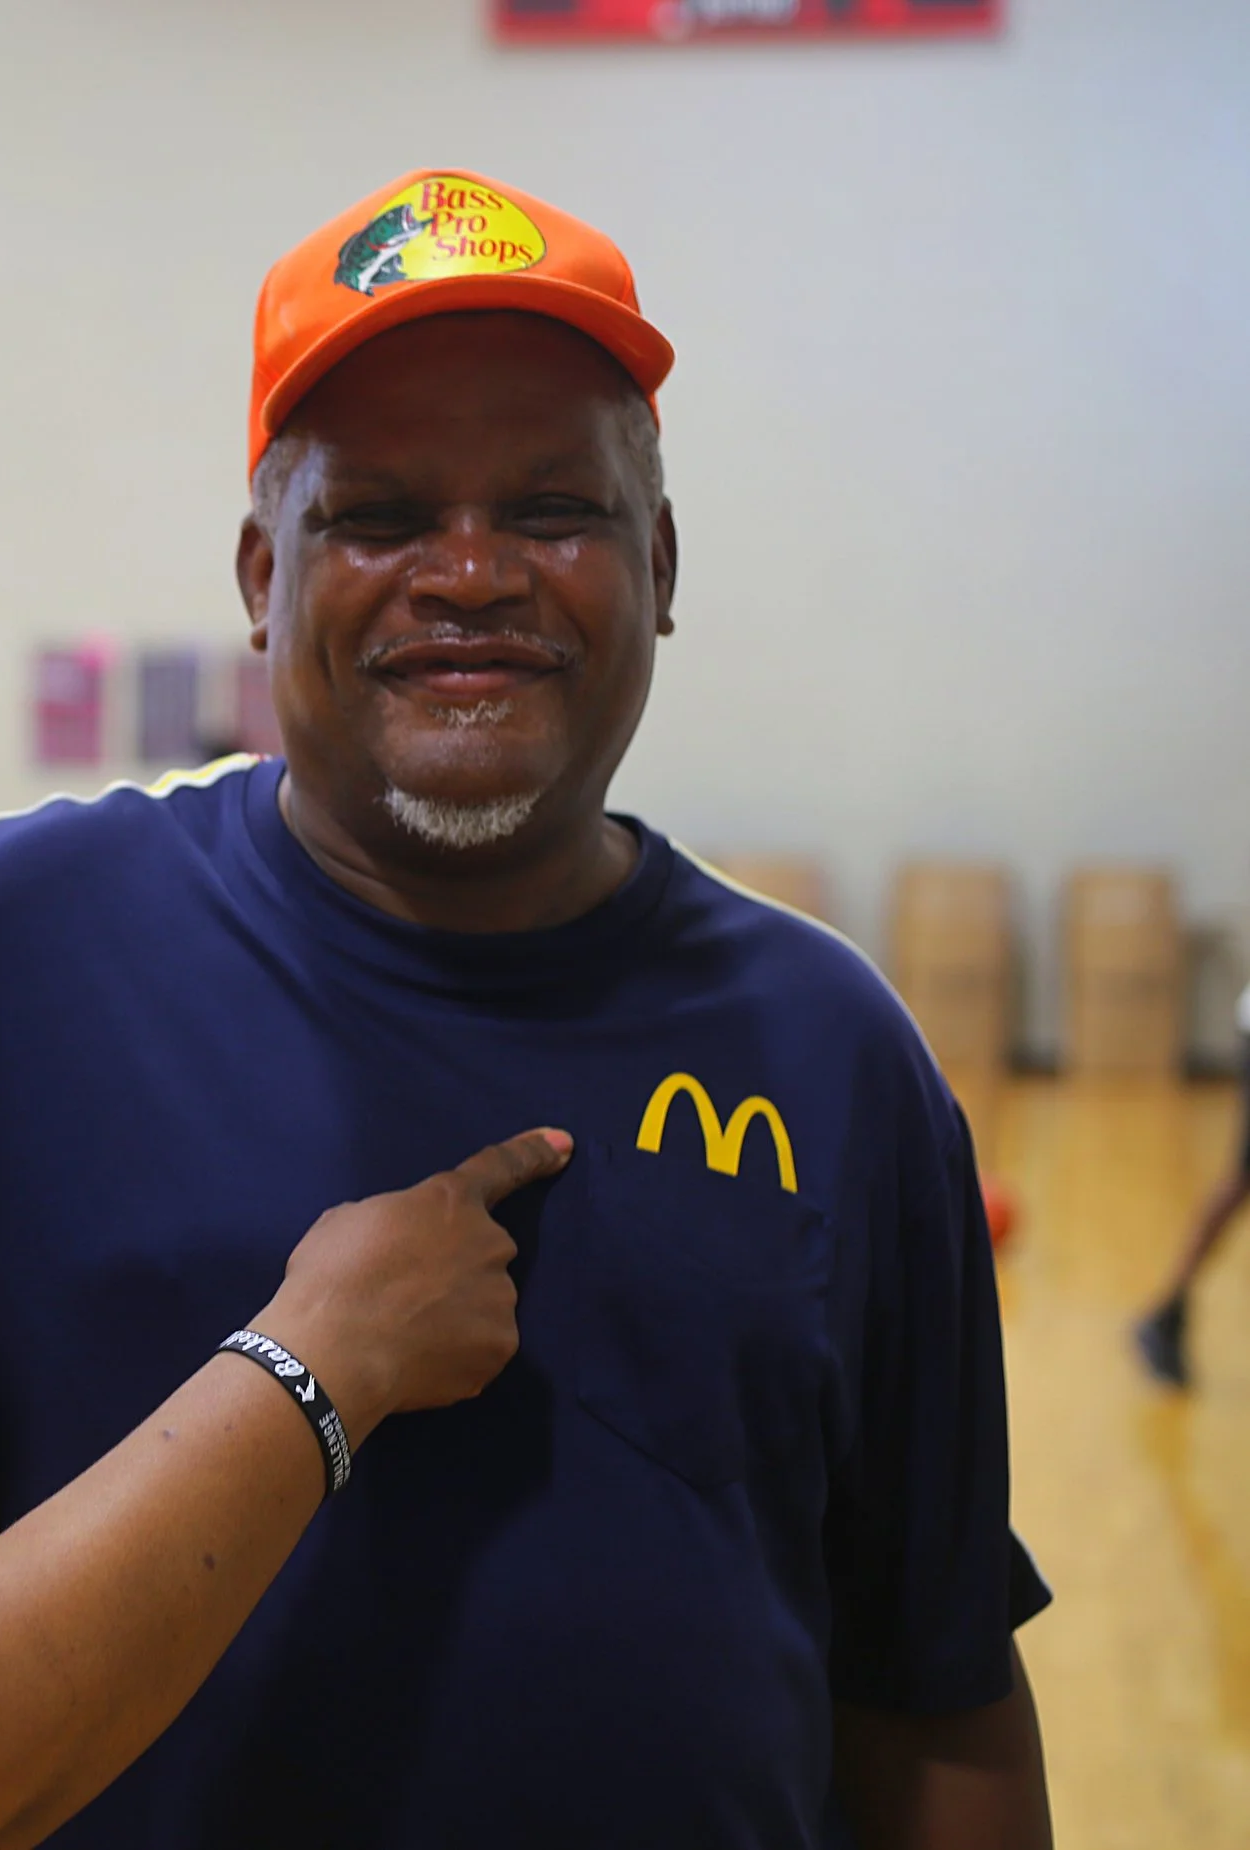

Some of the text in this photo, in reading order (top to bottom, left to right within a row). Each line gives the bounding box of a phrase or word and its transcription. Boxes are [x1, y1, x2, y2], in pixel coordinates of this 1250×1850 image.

[421, 181, 503, 211] Bass
[431, 211, 487, 236] Pro
[434, 235, 533, 263] Shops
